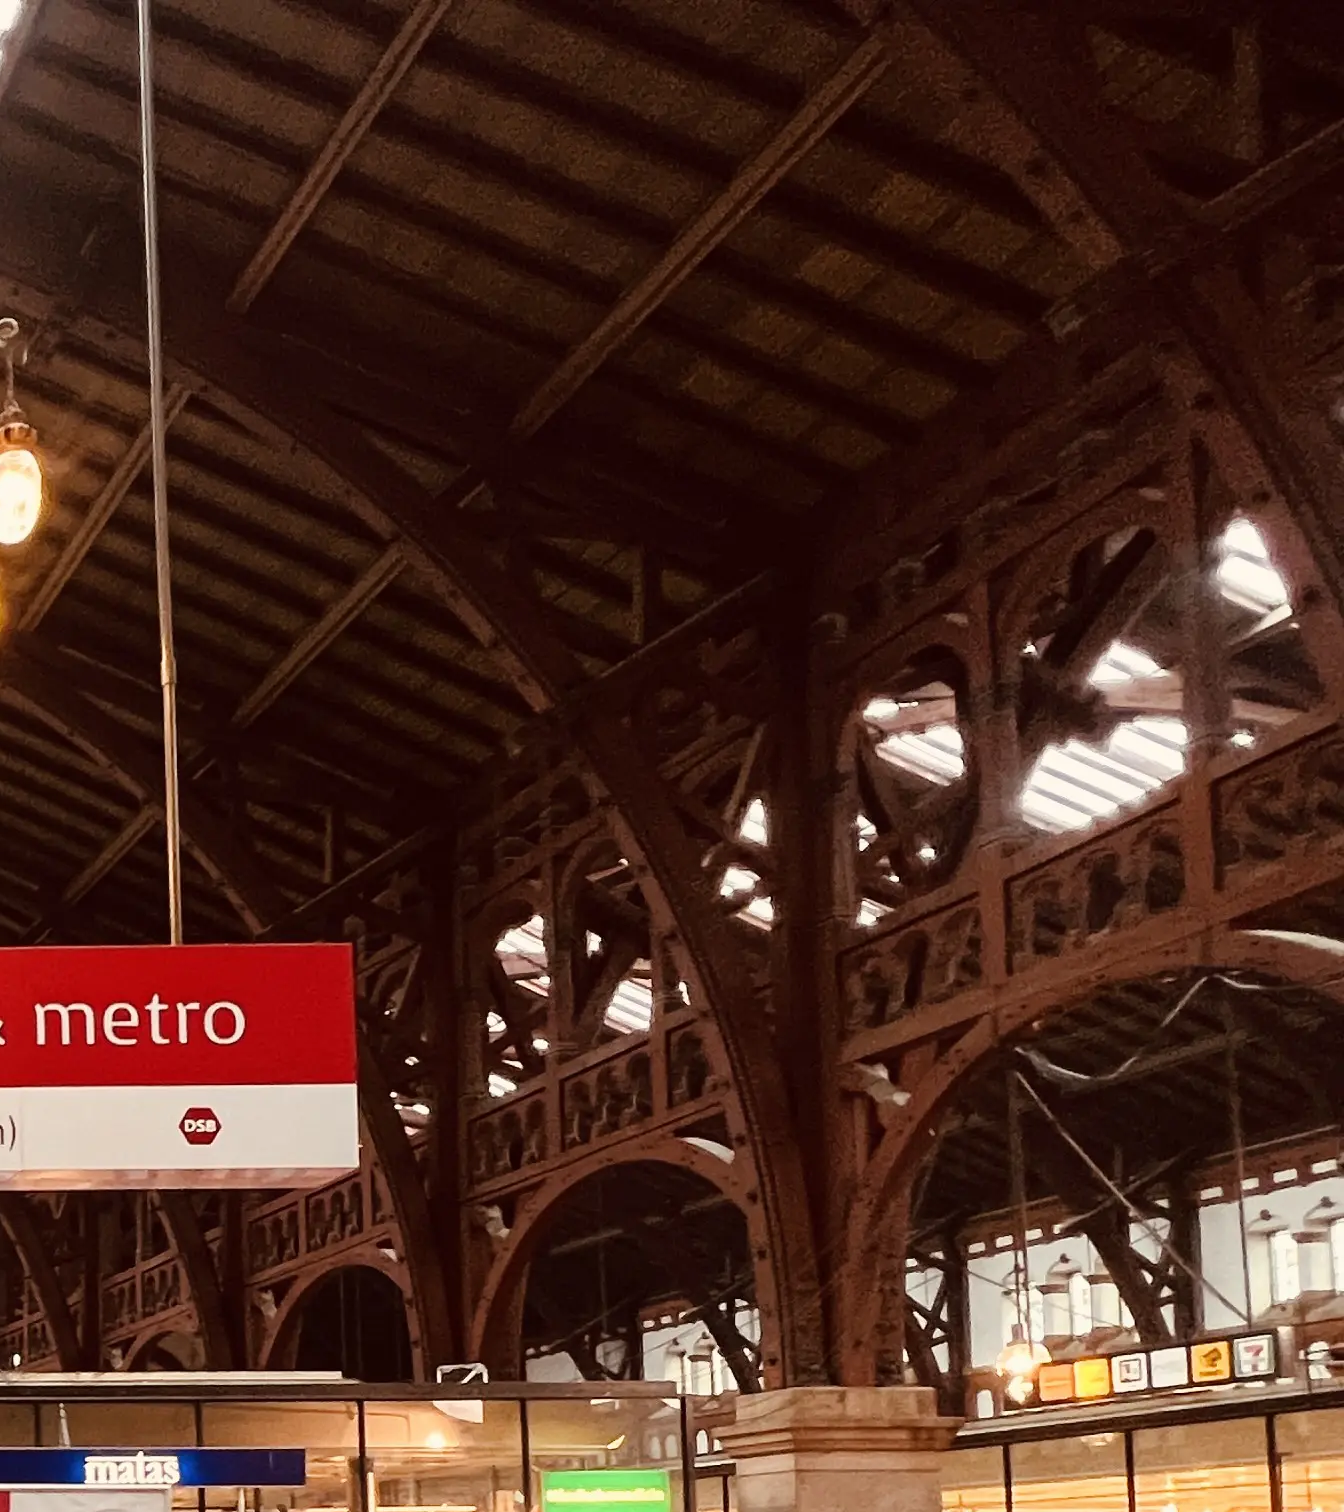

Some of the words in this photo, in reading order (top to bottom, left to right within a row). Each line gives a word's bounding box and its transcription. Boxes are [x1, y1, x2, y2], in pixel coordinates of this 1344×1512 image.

[35, 994, 245, 1045] metro
[184, 1120, 216, 1132] DSB
[84, 1451, 180, 1484] matas
